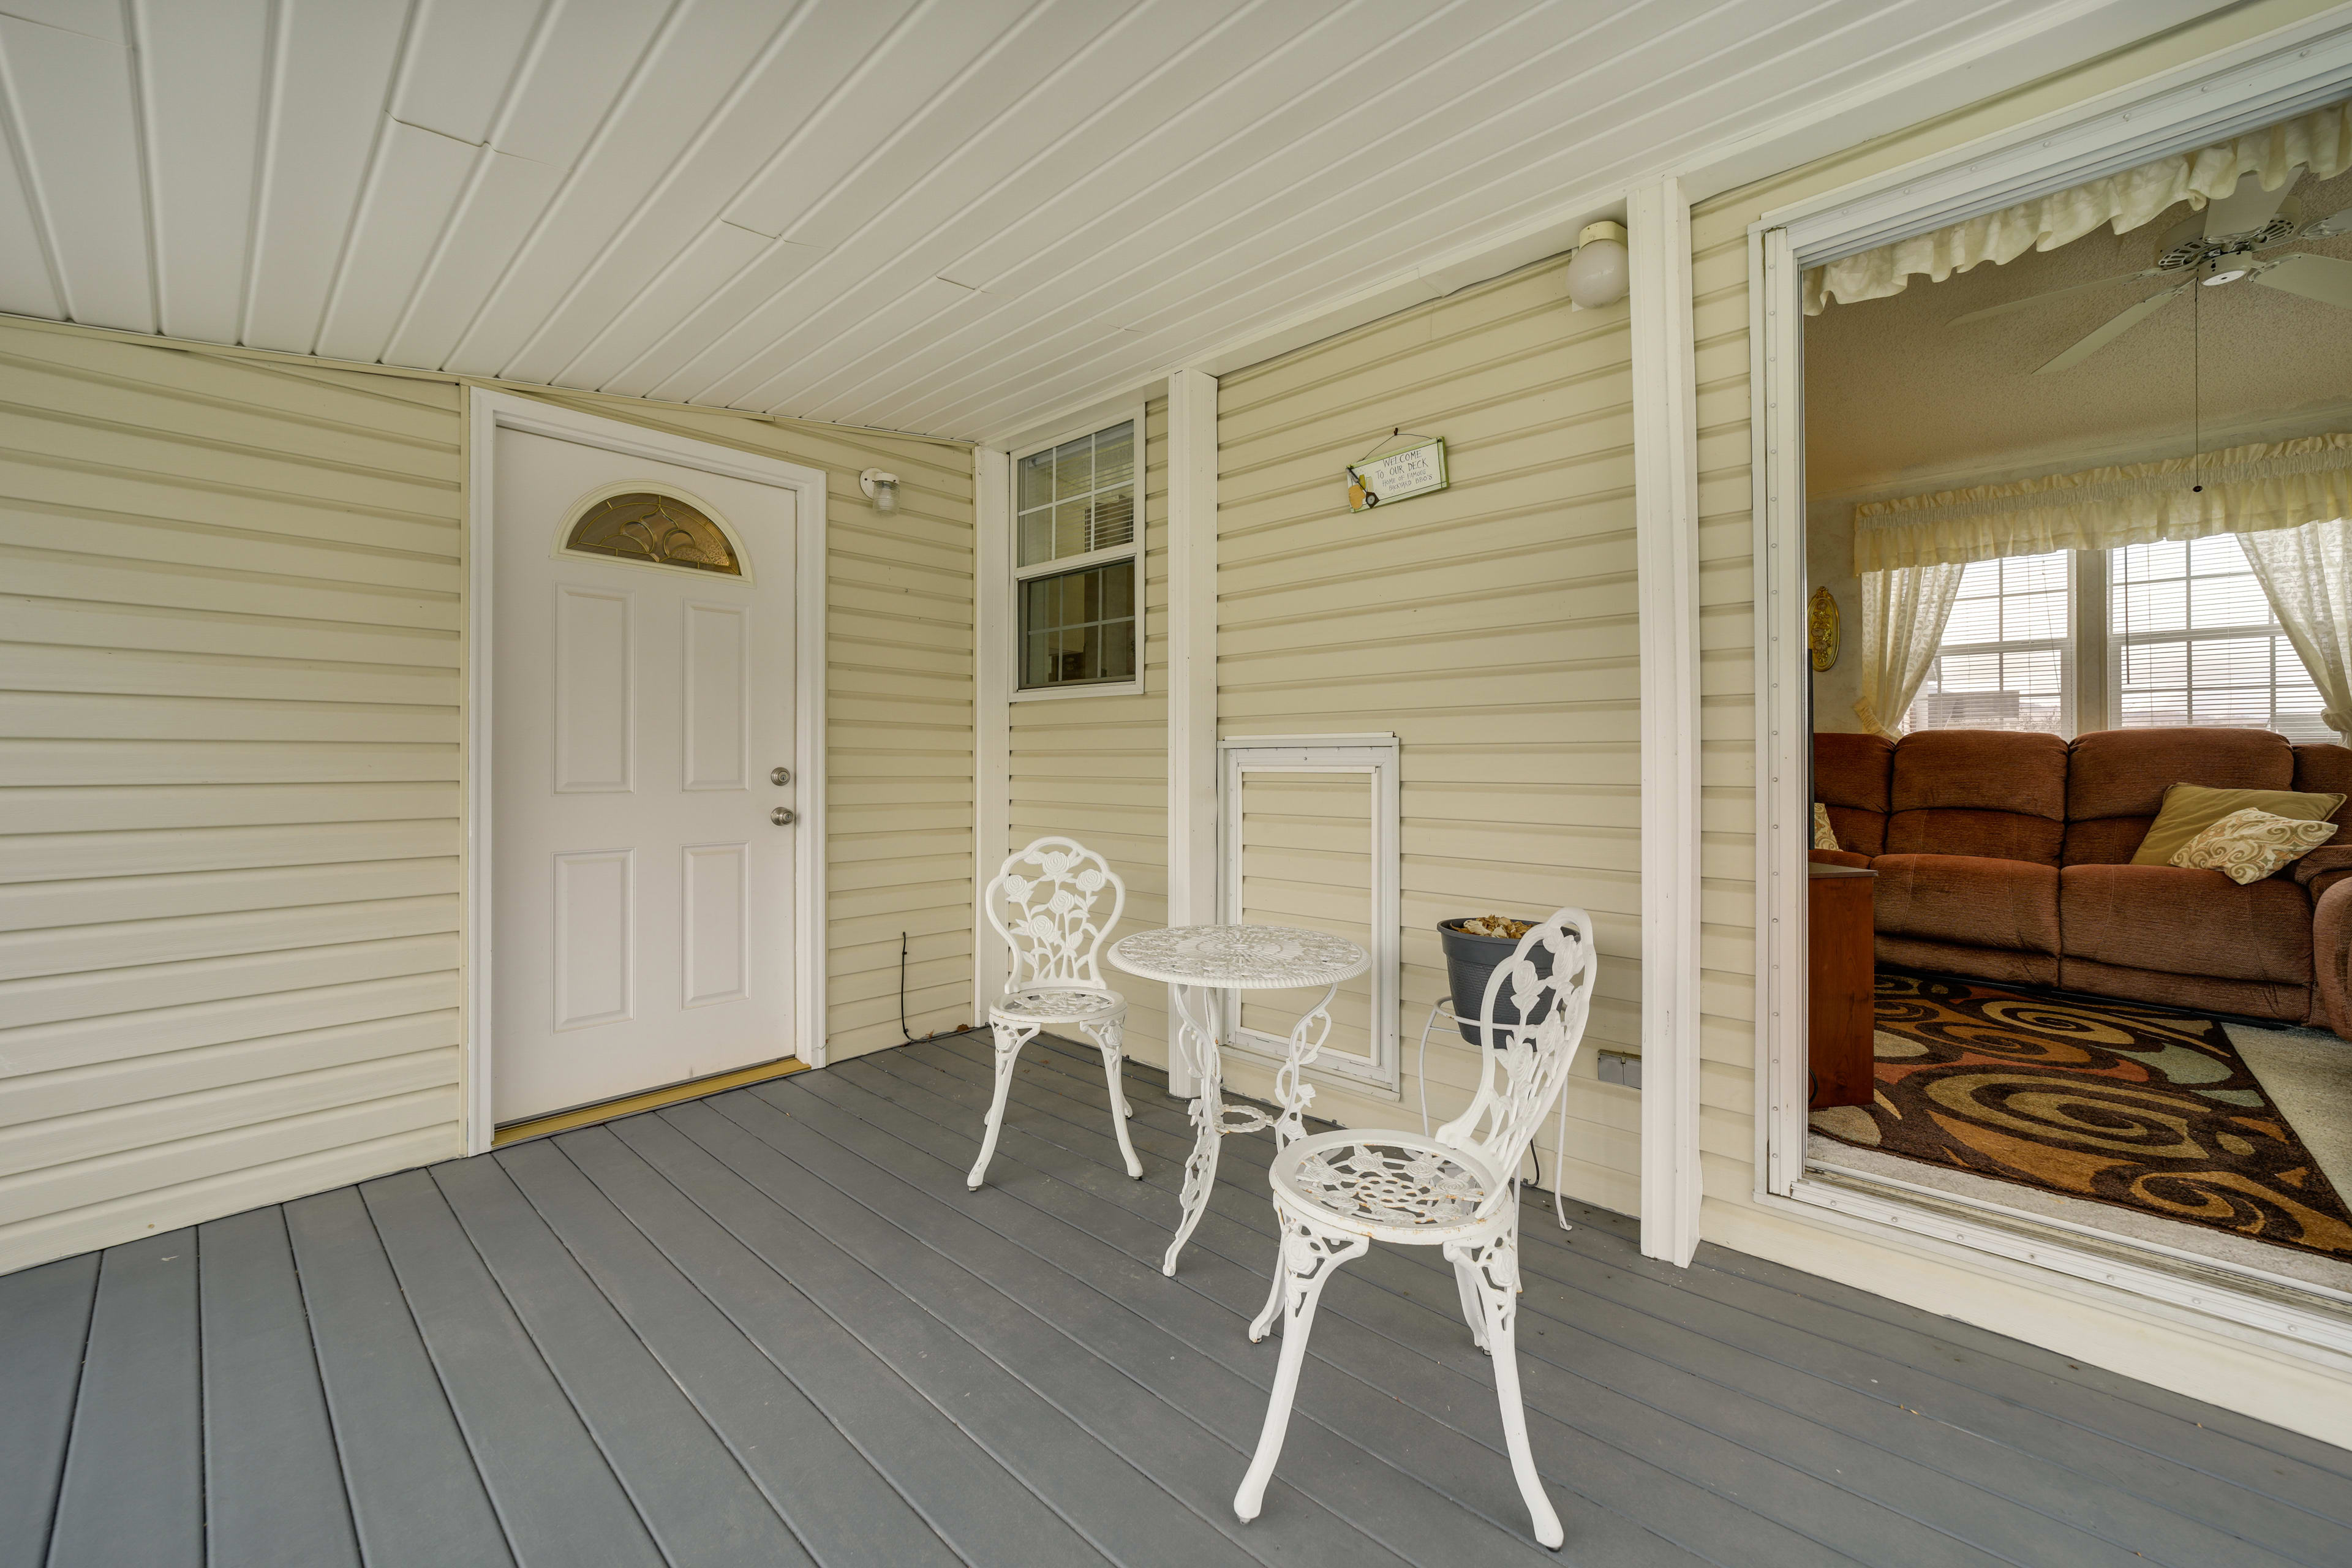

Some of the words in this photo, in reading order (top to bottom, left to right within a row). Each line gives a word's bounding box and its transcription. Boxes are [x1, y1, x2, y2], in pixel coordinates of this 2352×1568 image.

[1383, 450, 1422, 467] WELCOME
[1375, 469, 1384, 480] TO
[1389, 466, 1404, 476] OUR
[1408, 458, 1428, 471] DECK
[1382, 478, 1396, 487] HOME
